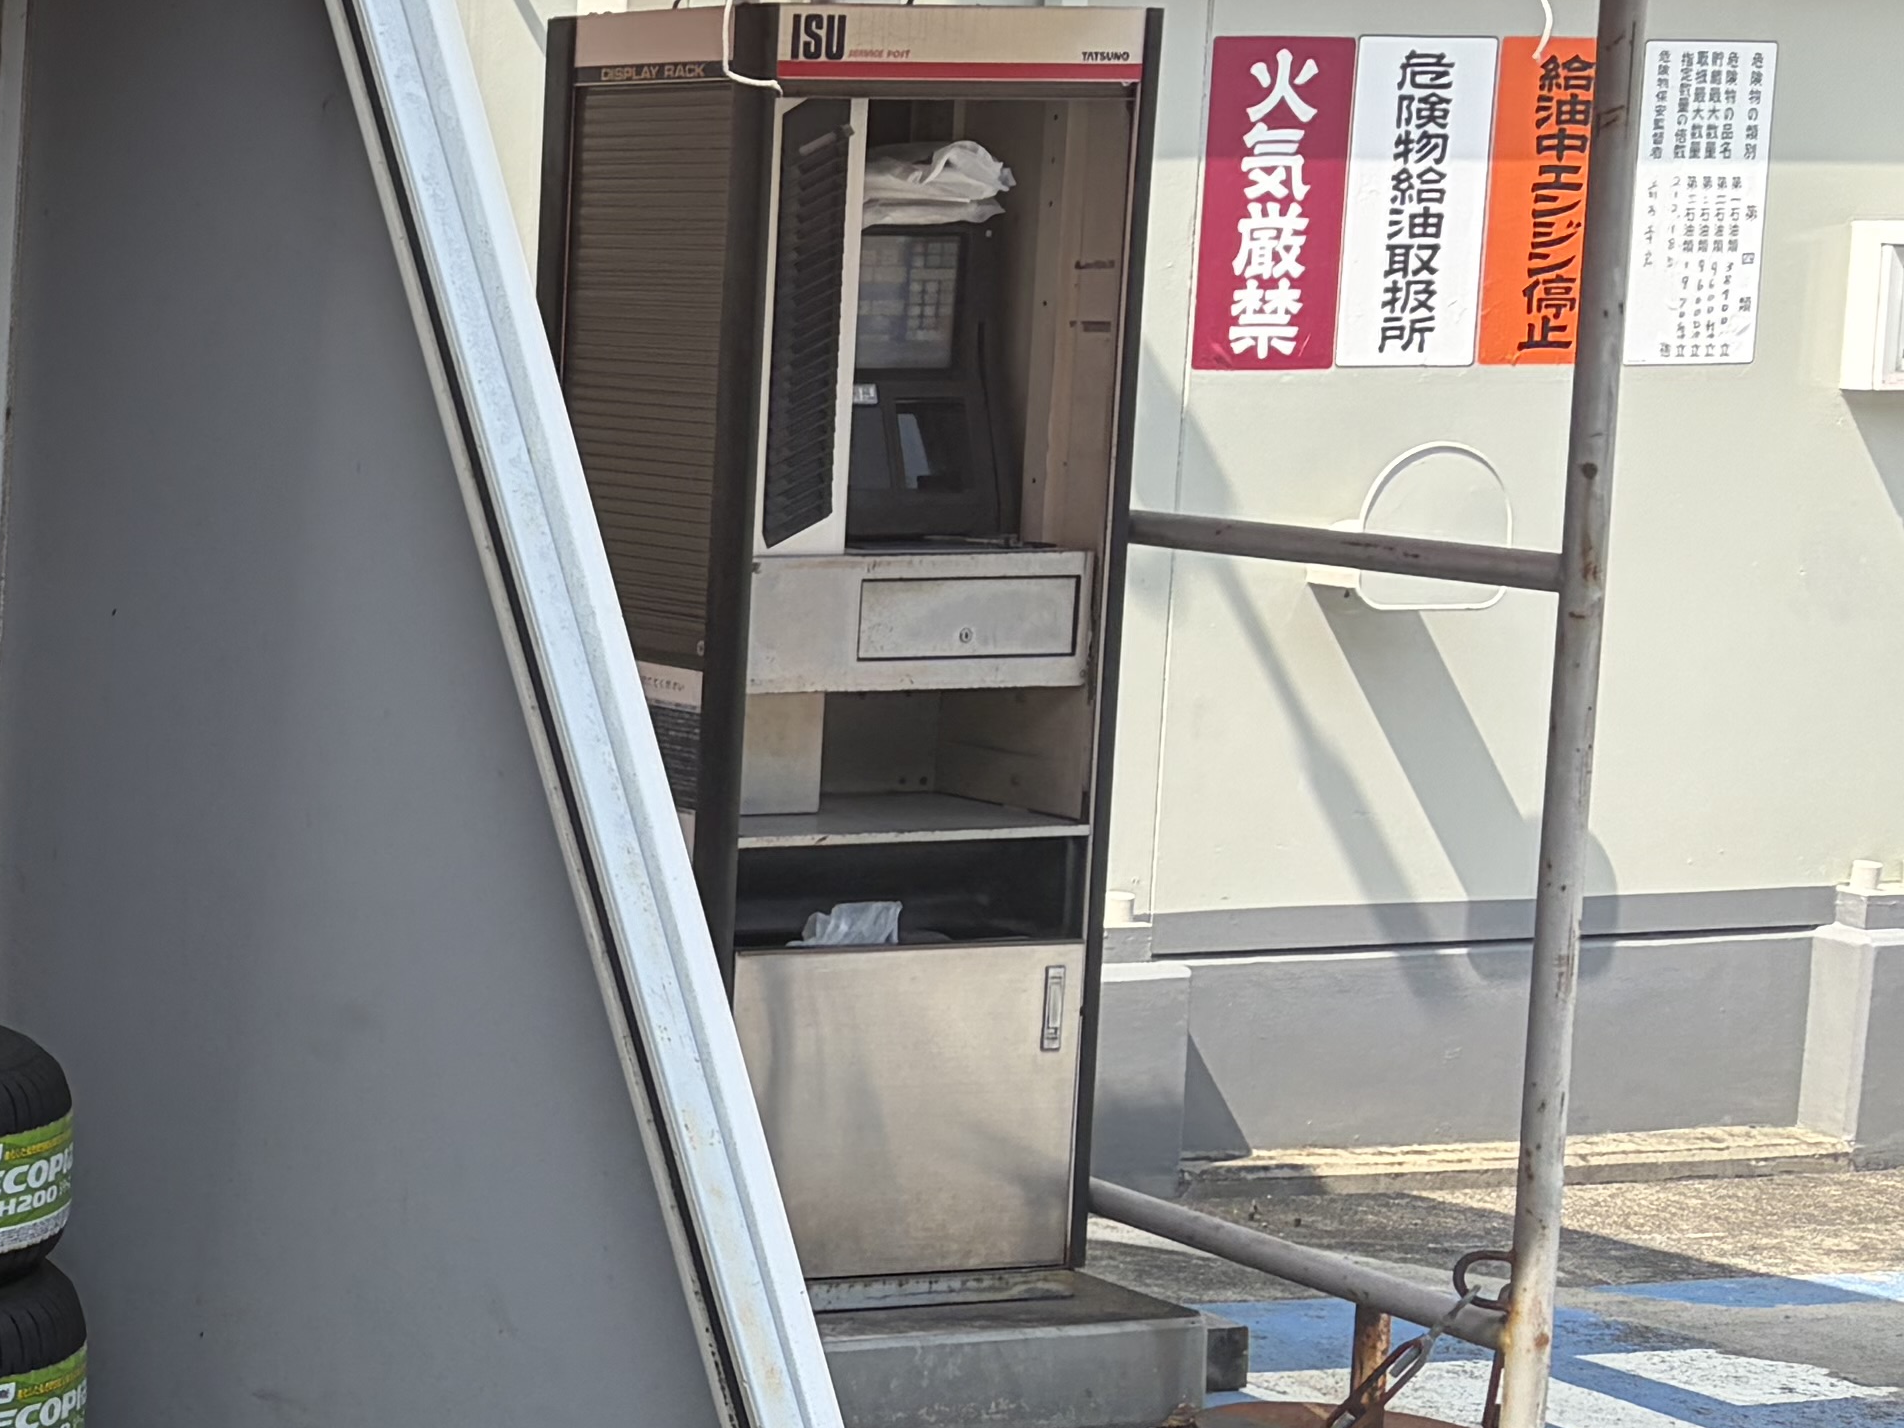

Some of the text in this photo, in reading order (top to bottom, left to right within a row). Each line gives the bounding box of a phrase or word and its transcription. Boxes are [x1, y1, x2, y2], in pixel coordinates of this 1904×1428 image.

[601, 64, 705, 80] DISPLAY RACK
[790, 14, 847, 60] ISU
[1082, 51, 1130, 62] TATSUNO
[1228, 48, 1319, 359] 火気厳禁
[1378, 49, 1455, 355] 危険物給油取扱所
[1517, 53, 1597, 351] 給油中エンジン停止
